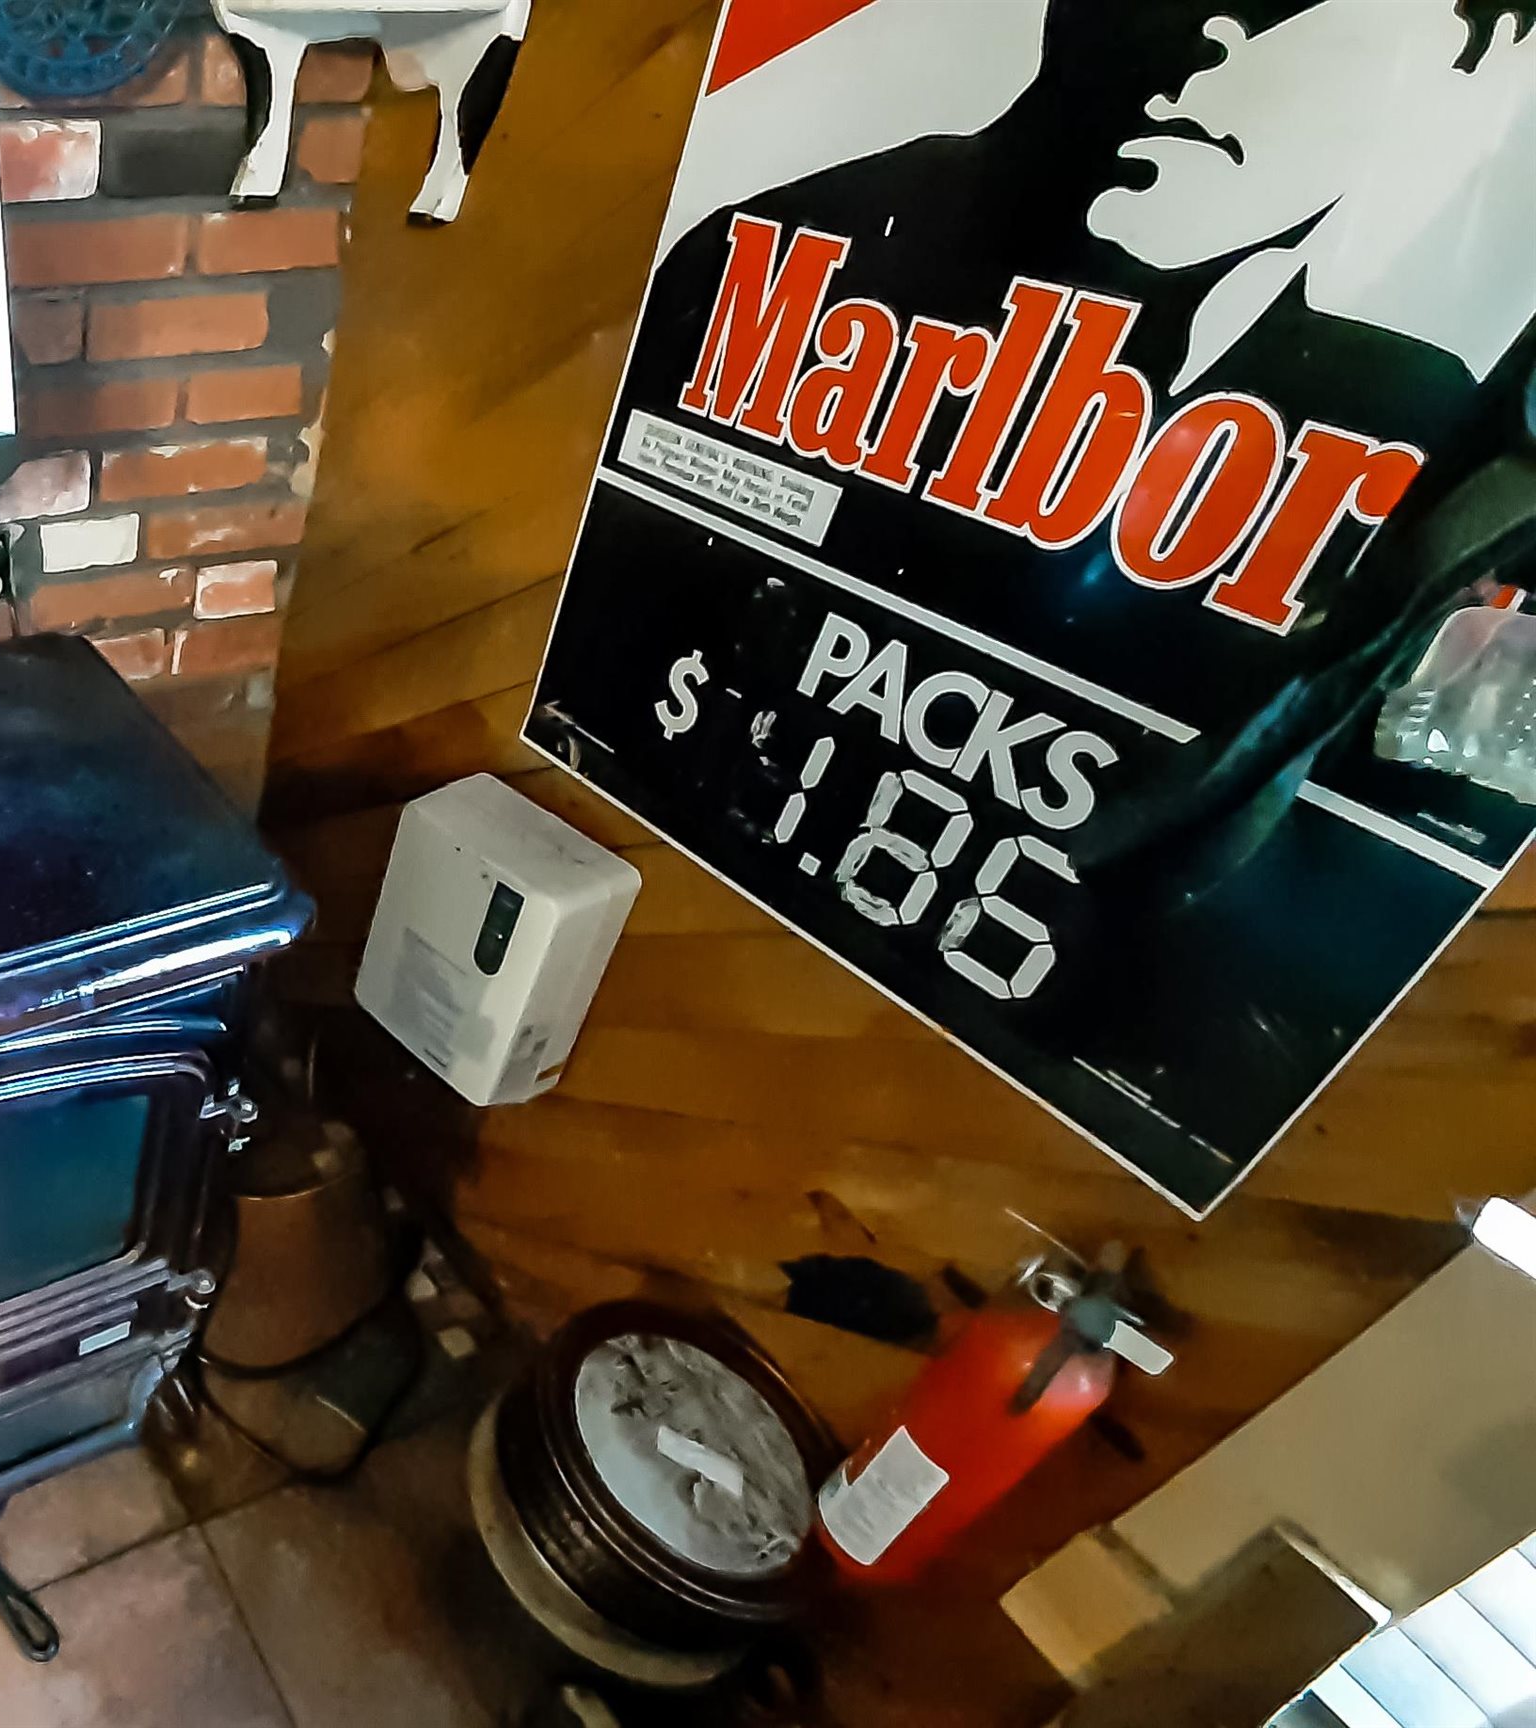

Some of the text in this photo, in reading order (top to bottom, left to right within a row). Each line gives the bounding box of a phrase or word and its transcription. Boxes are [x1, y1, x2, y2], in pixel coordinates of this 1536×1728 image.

[677, 211, 1430, 637] Marlbor
[654, 649, 709, 741] $
[796, 612, 1119, 830] PACKS
